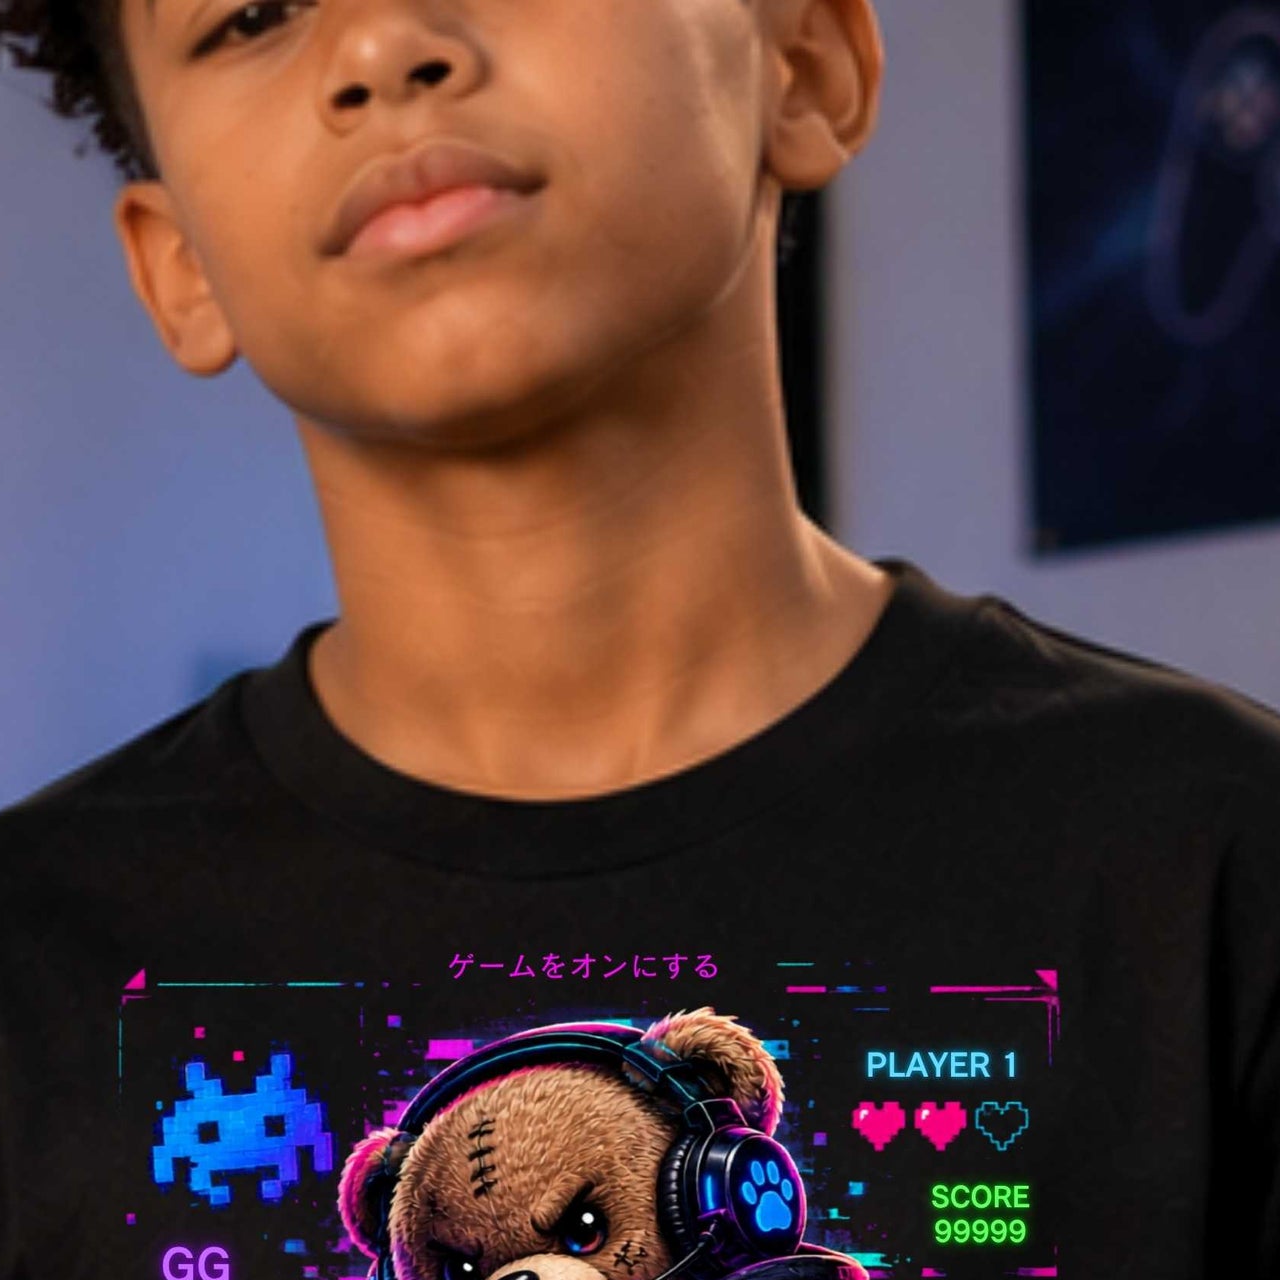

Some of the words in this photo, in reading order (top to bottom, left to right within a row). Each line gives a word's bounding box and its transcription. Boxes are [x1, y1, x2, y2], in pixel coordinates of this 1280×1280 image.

[449, 952, 719, 979] ゲームをオンにする
[866, 1051, 991, 1078] PLAYER
[1004, 1051, 1015, 1078] 1
[931, 1184, 1030, 1209] SCORE
[934, 1218, 1027, 1244] 99999
